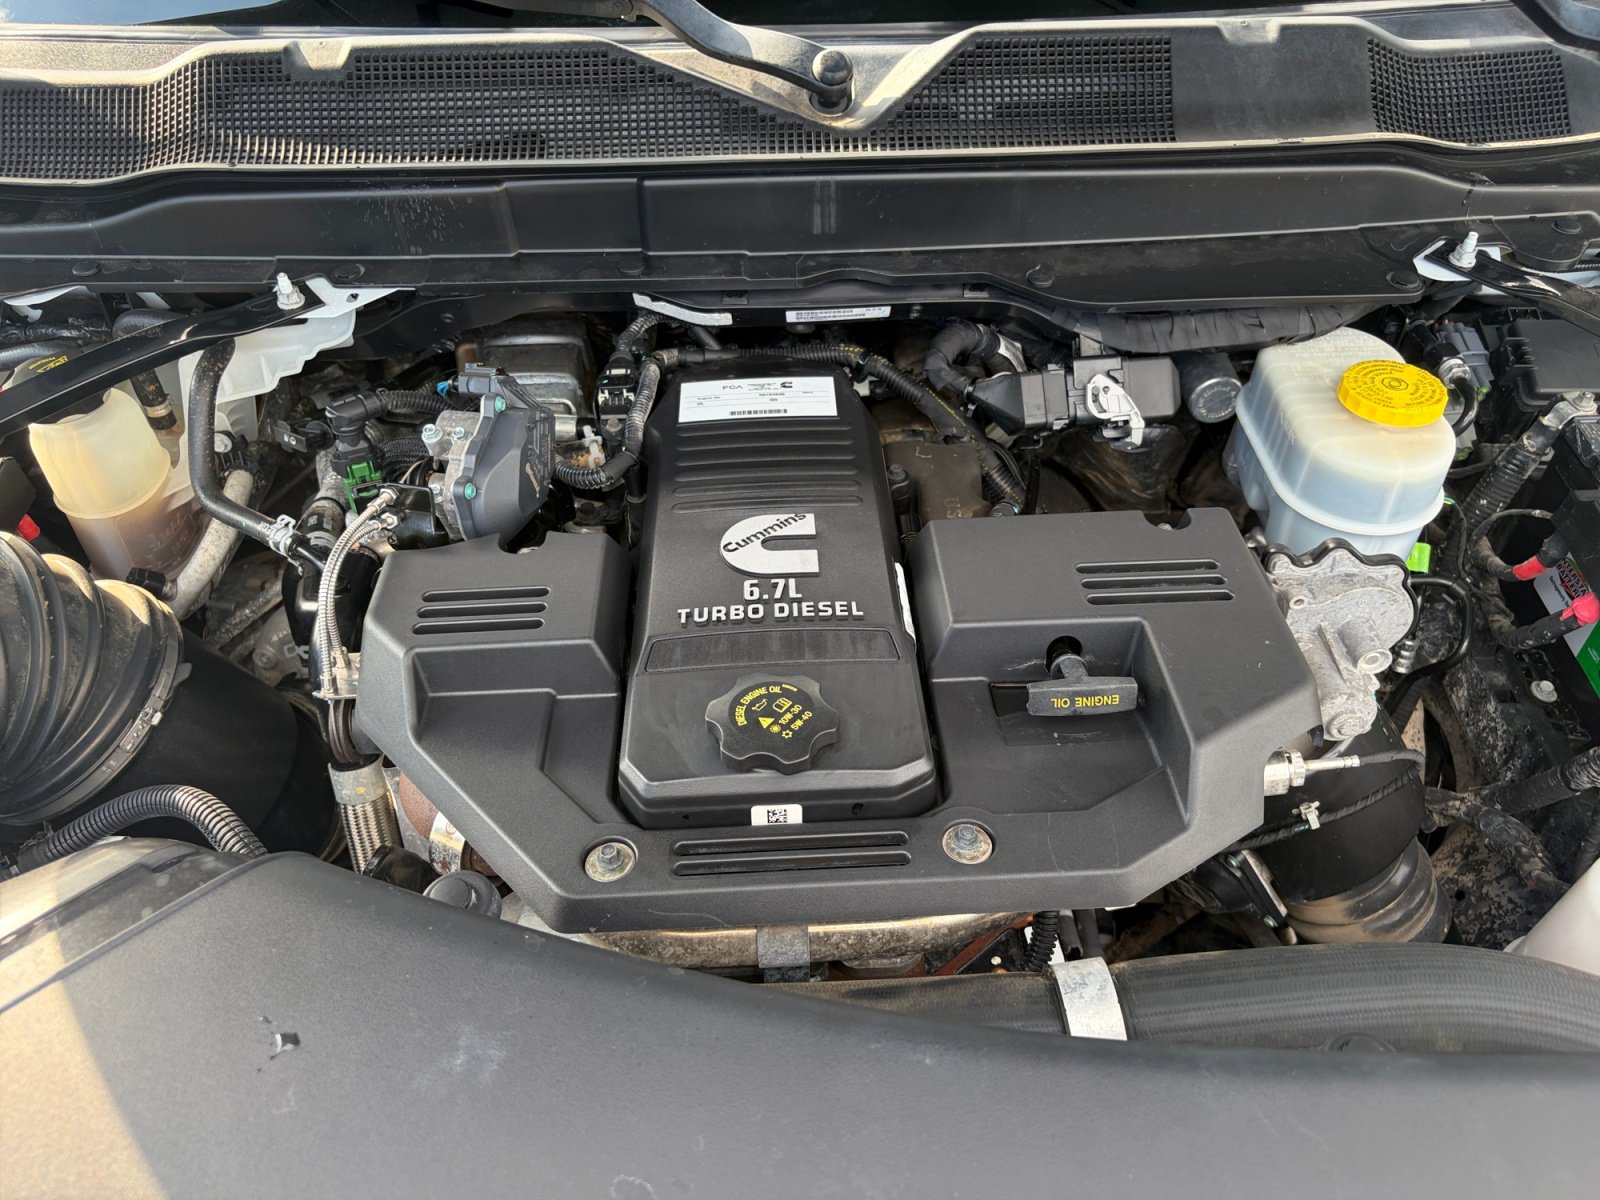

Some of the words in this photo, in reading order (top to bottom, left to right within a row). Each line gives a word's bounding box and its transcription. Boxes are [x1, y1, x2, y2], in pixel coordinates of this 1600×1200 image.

[722, 513, 807, 553] Cummins
[743, 578, 803, 601] 6.7L
[677, 603, 765, 624] TURBO
[774, 601, 864, 619] DIESEL
[740, 687, 768, 705] ENGINE
[1050, 697, 1071, 709] OIL
[1074, 694, 1120, 707] ENGINE
[735, 705, 748, 726] DIESEL
[778, 704, 803, 725] 10W-30
[790, 711, 813, 731] 5W-40
